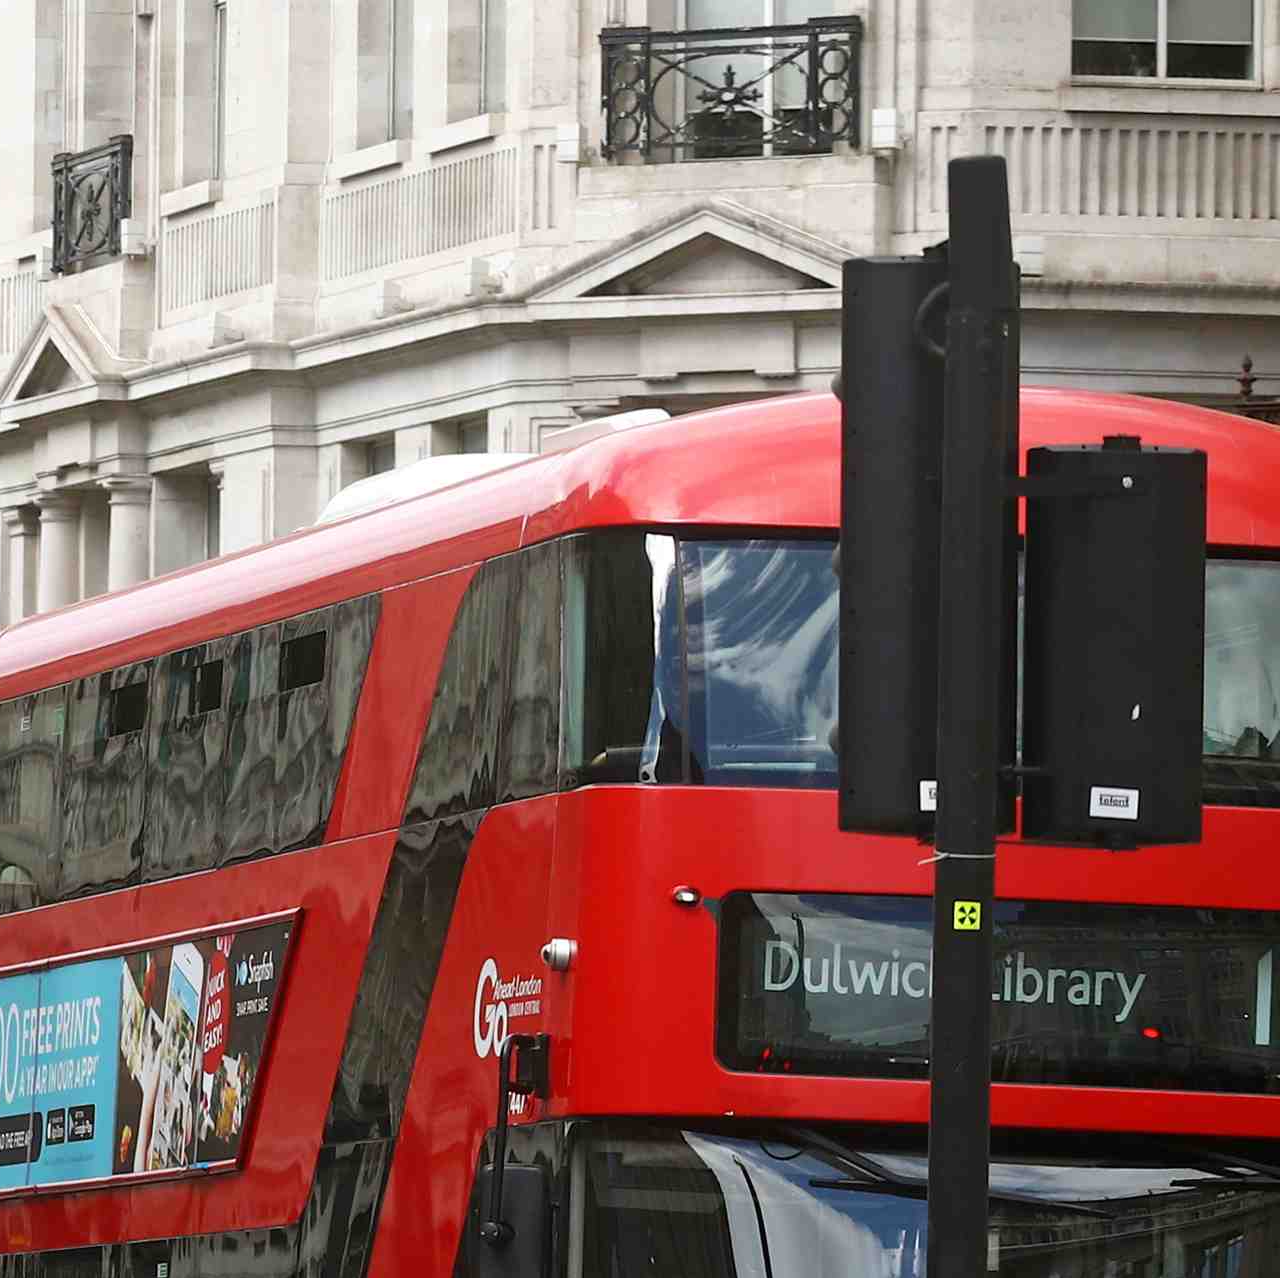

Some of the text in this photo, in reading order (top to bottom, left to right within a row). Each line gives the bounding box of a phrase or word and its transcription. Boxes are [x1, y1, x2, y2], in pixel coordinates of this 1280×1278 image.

[474, 958, 508, 1058] Go
[762, 940, 1147, 1023] Dulwic ibrary
[22, 1005, 53, 1057] FREE
[55, 996, 101, 1051] PRINTS
